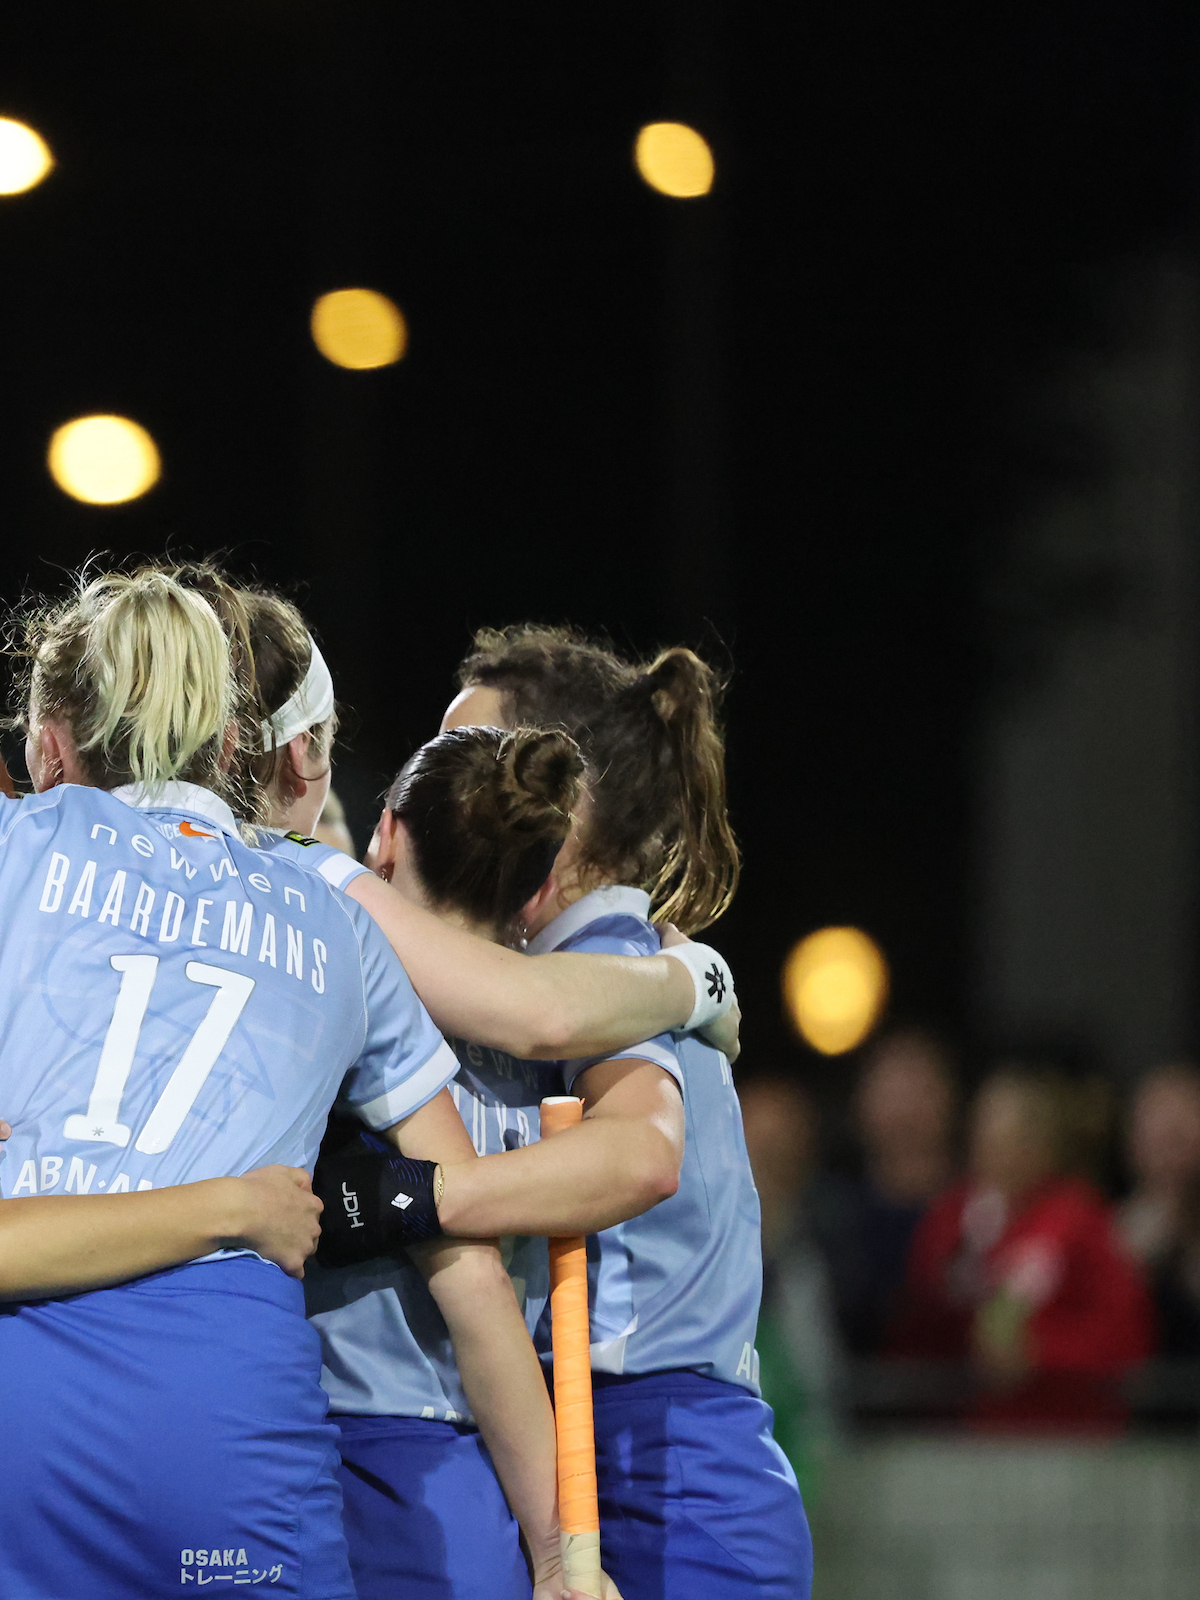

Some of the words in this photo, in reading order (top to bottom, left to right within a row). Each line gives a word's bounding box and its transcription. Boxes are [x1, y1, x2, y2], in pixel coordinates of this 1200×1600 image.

[39, 852, 327, 994] BAARDEMANS
[63, 954, 256, 1154] 17
[181, 1548, 249, 1567] OSAKA
[181, 1564, 283, 1586] トレーニング
